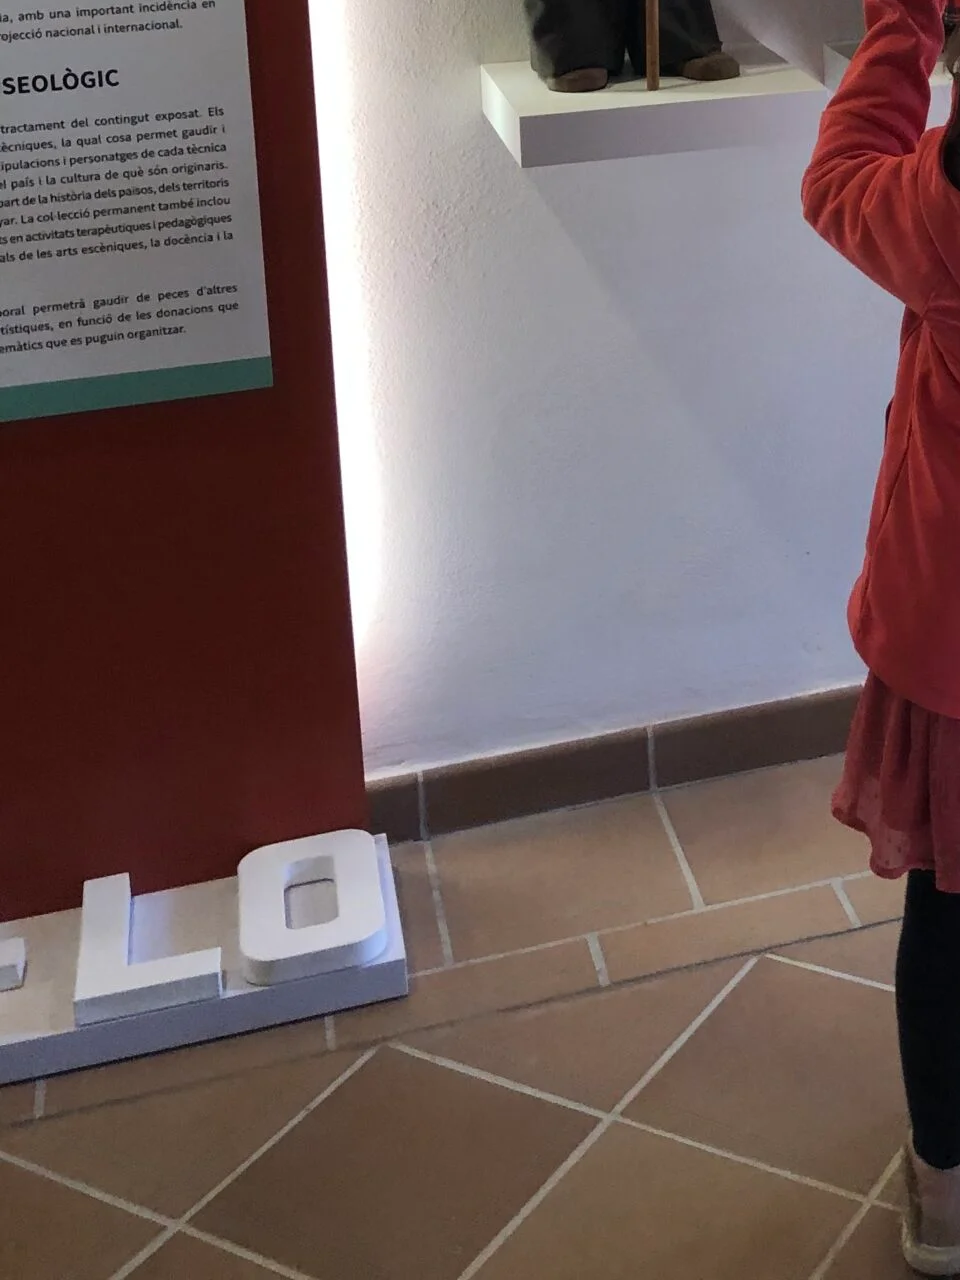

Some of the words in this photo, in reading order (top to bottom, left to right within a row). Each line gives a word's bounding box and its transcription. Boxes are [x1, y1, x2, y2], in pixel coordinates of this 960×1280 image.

[18, 9, 44, 20] amb
[49, 10, 71, 18] una
[76, 4, 135, 18] important
[139, 0, 197, 13] incidència
[202, 1, 215, 9] en
[2, 67, 120, 95] SEOLÒGIC
[70, 117, 89, 128] del
[94, 113, 149, 126] contingut
[208, 107, 224, 117] Els
[46, 339, 68, 351] que
[70, 338, 82, 346] es
[85, 331, 124, 347] puguin
[127, 327, 186, 342] organitzar.
